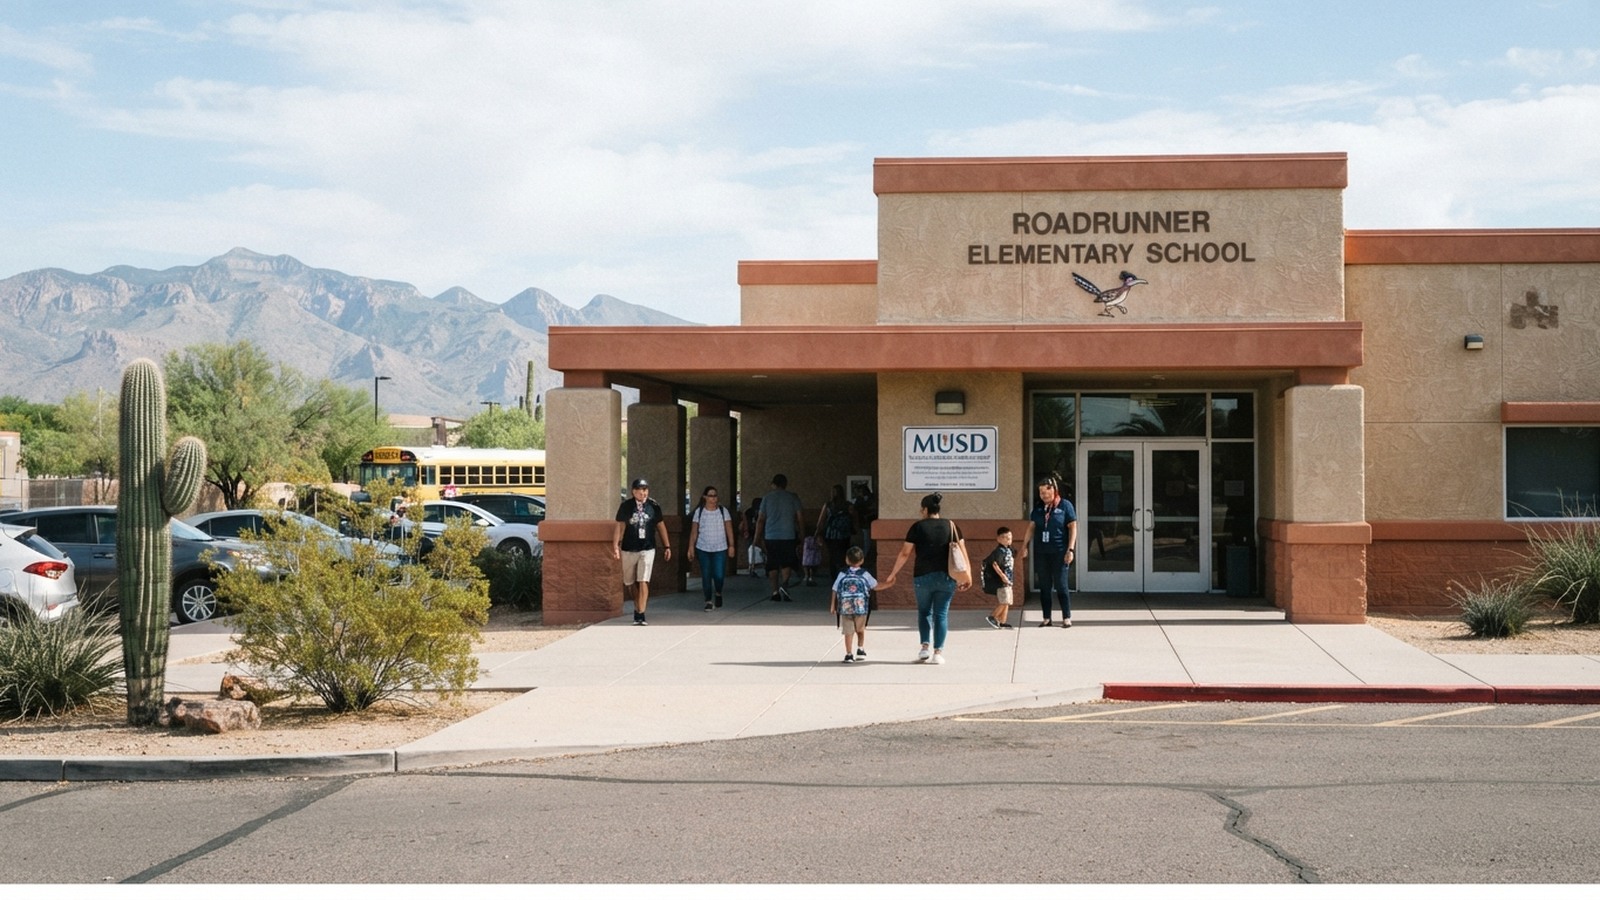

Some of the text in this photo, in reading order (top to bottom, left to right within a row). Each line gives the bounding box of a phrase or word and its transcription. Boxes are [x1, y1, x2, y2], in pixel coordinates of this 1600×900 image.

[1012, 210, 1211, 236] ROADRUNNER
[968, 242, 1256, 265] ELEMENTARY SCHOOL
[913, 433, 988, 454] MUSD
